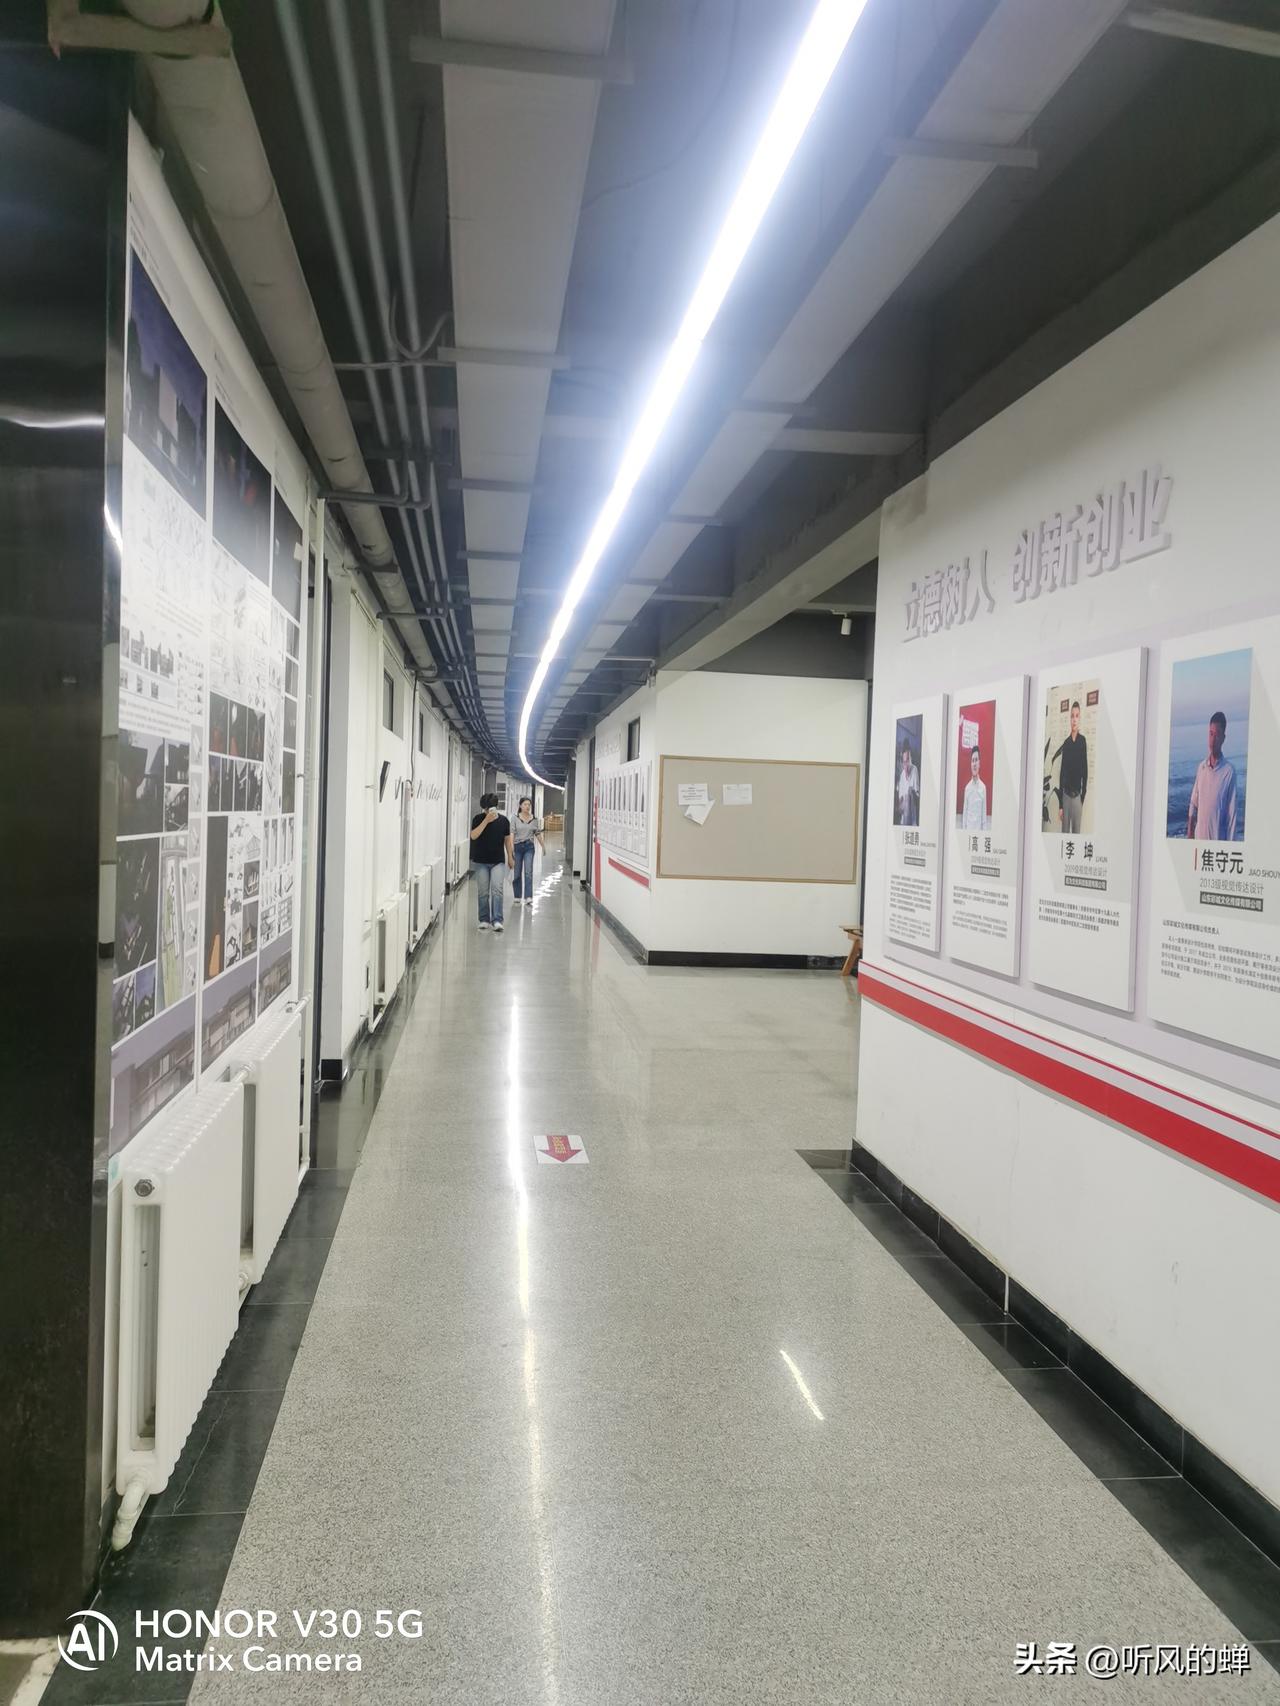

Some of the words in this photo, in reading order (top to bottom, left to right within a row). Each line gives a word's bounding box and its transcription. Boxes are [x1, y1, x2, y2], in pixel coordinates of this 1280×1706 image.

[902, 549, 995, 643] 立德树人
[1011, 466, 1174, 604] 创新创业
[1201, 849, 1244, 875] 焦守元
